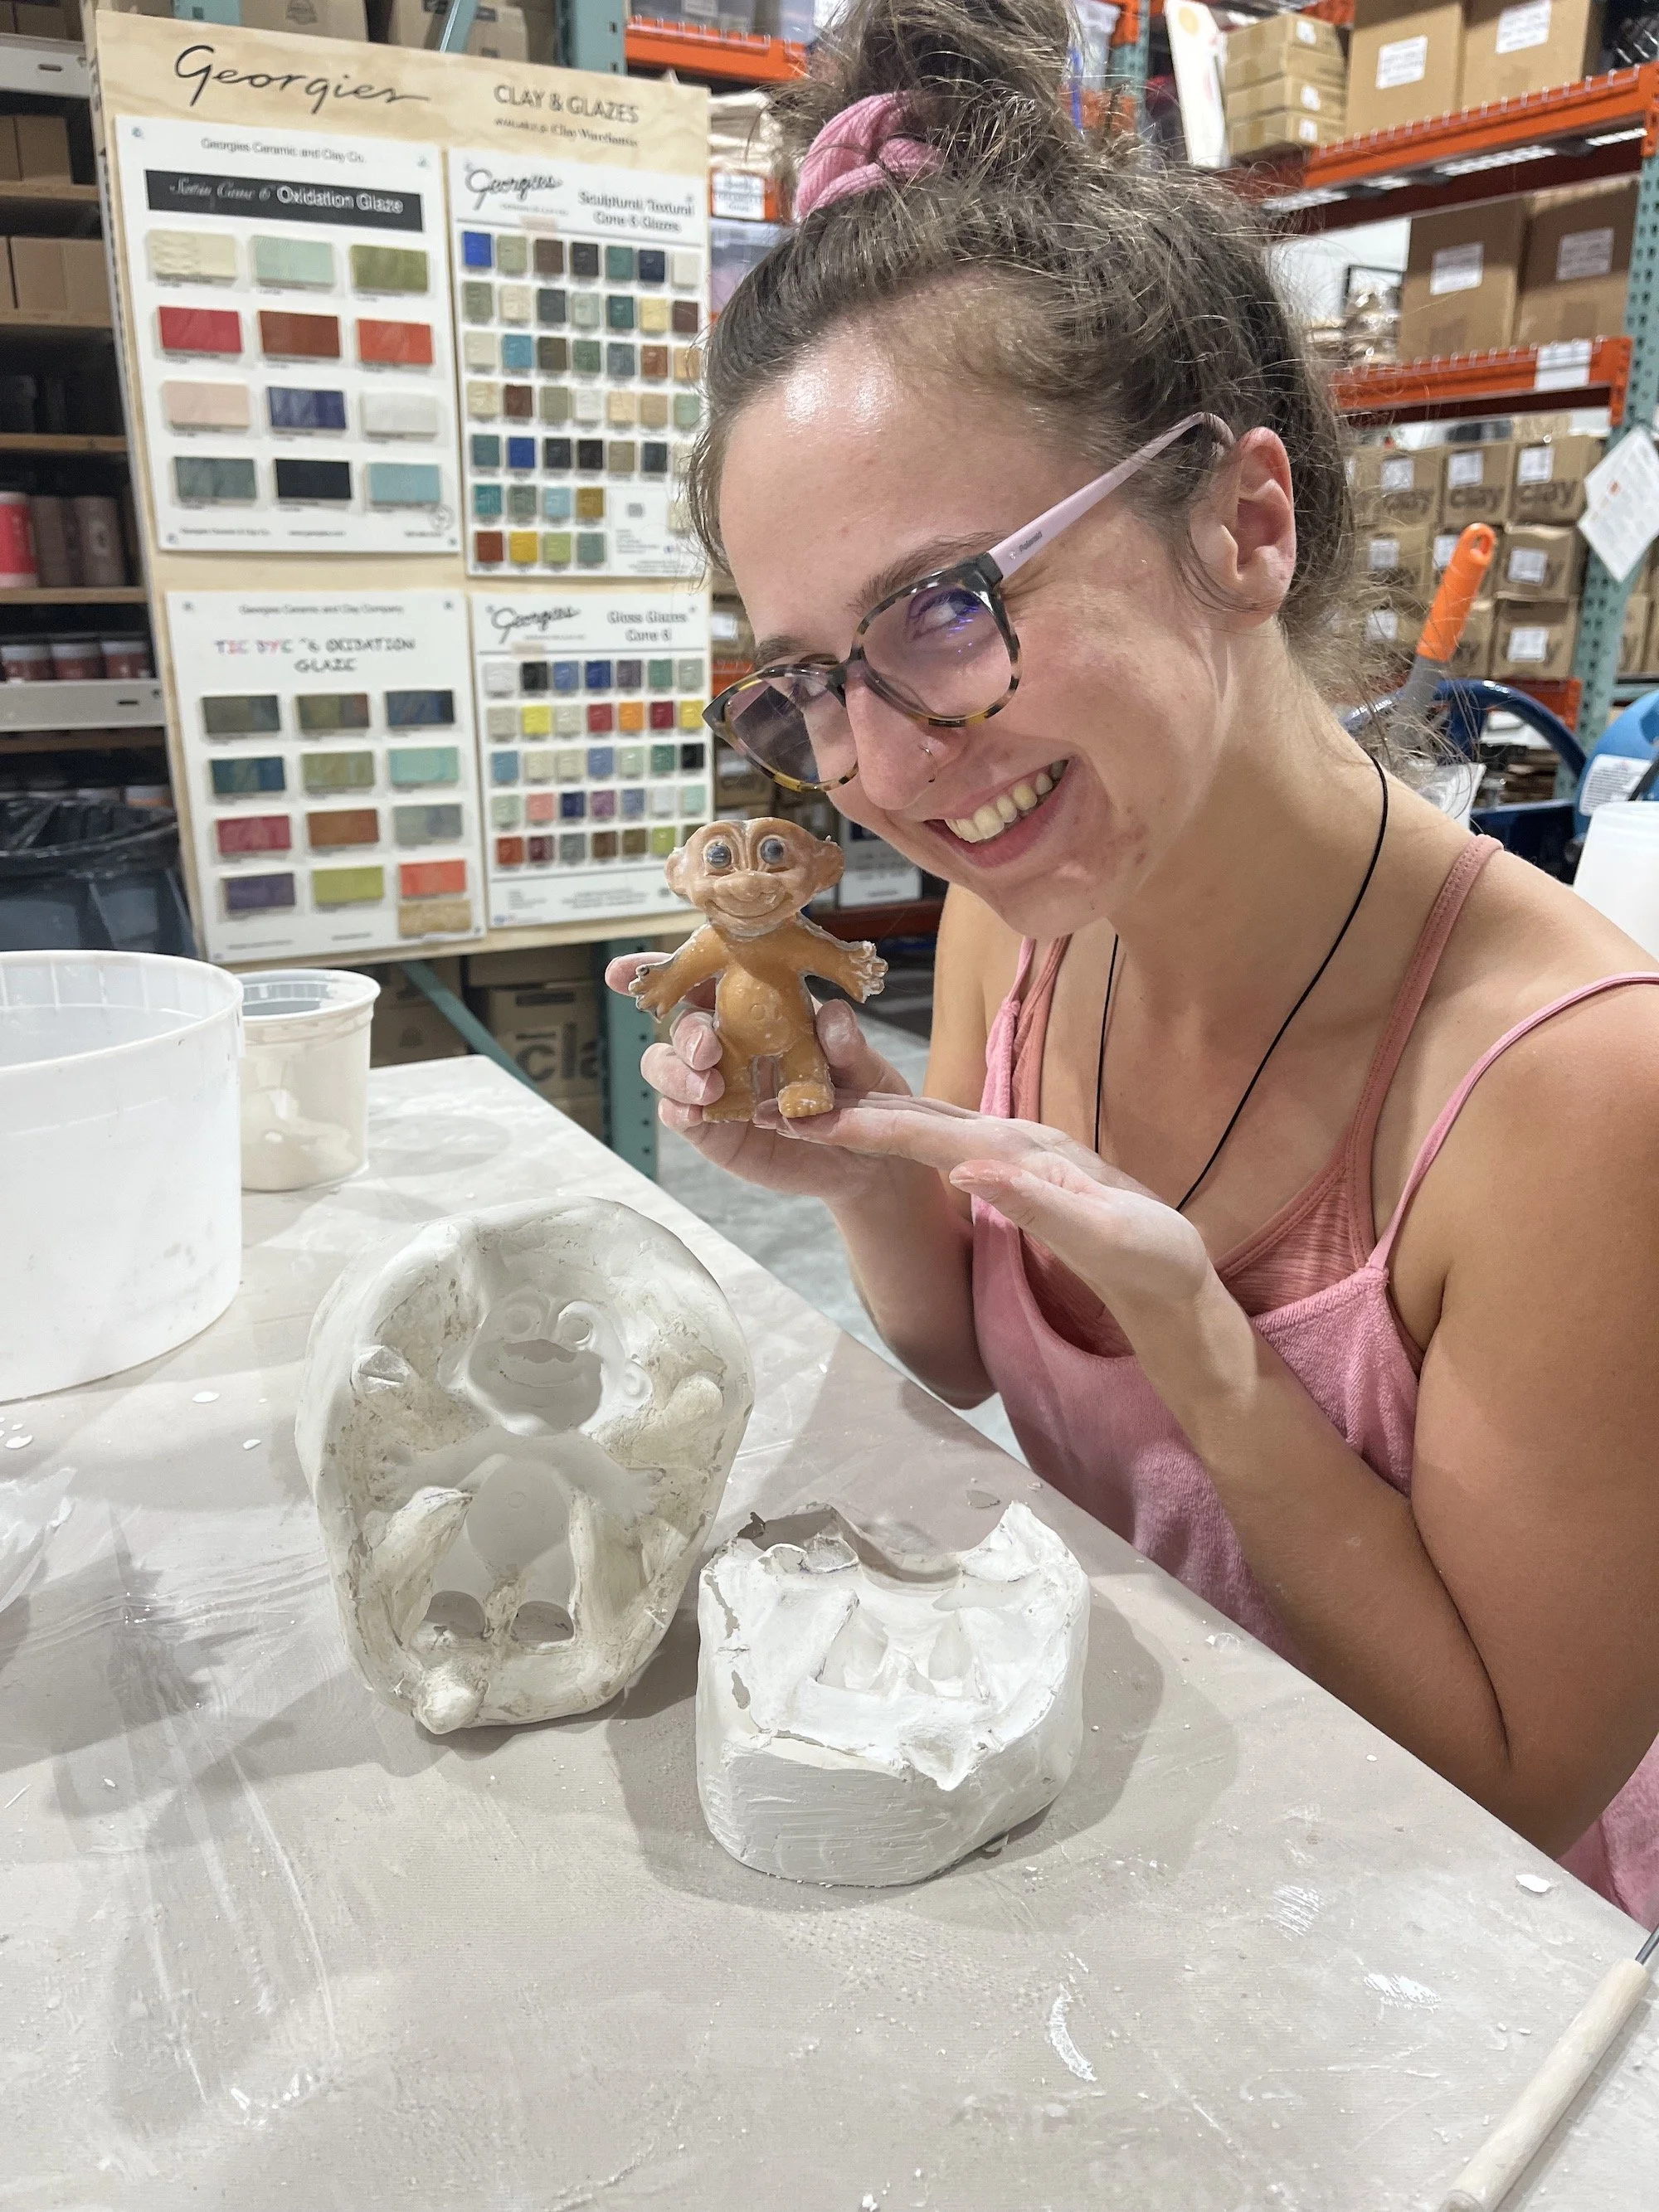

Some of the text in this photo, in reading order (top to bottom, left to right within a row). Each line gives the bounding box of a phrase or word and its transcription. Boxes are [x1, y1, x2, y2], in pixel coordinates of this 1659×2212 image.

[174, 44, 430, 114] Georgies
[493, 84, 640, 124] CLAY & GLAZES
[276, 184, 354, 209] Oxidation
[355, 192, 405, 214] Glaze
